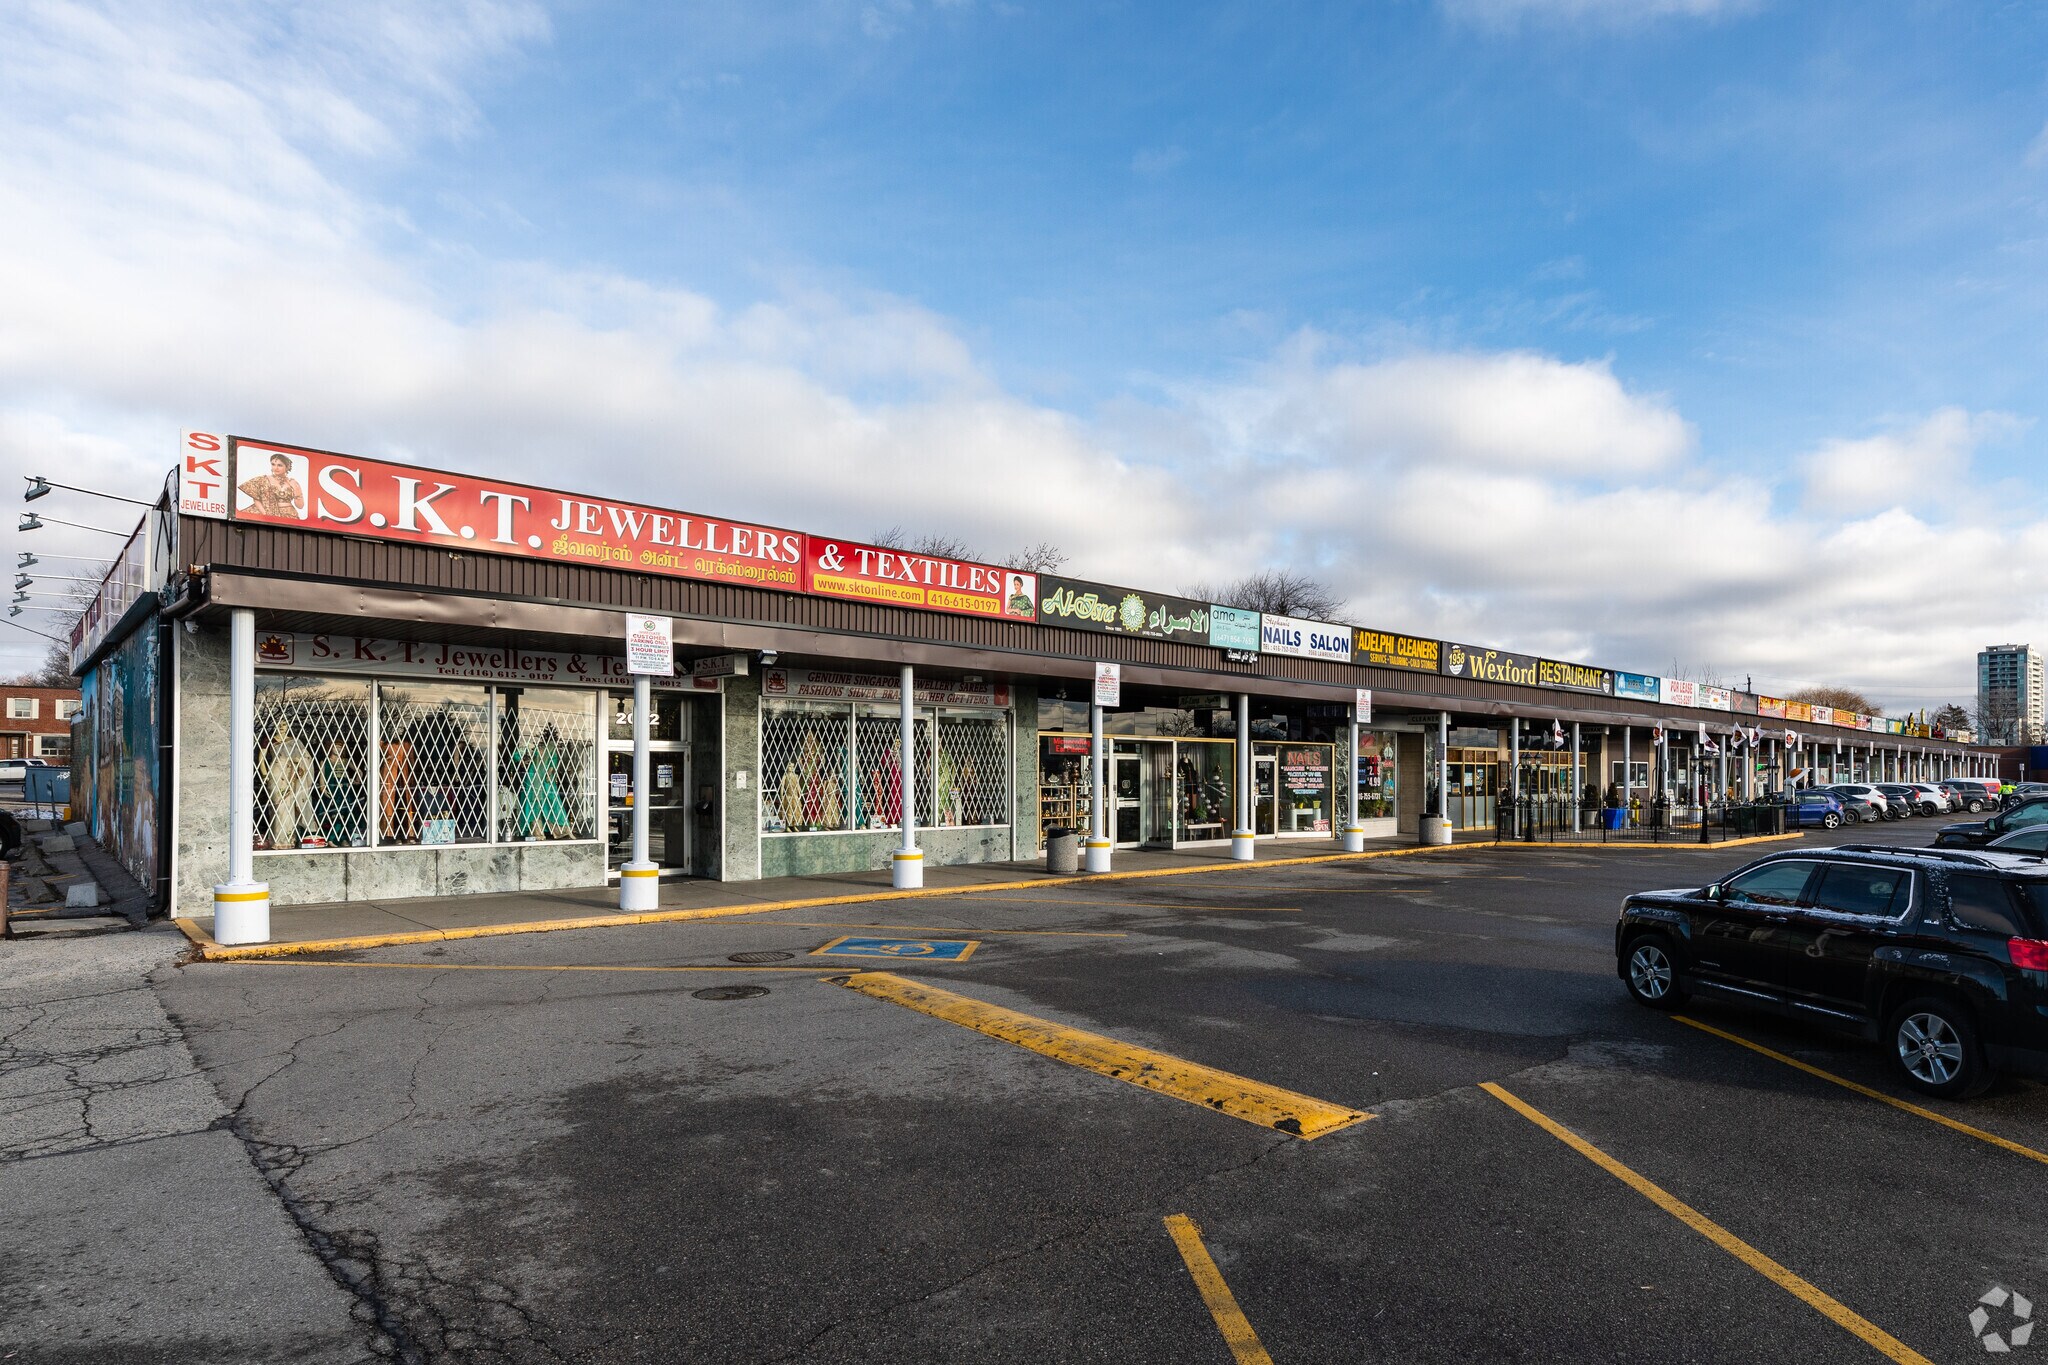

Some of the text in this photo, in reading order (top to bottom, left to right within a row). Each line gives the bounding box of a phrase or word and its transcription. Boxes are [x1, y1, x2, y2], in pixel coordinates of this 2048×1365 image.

[180, 499, 226, 514] JEWELLERS
[316, 464, 1001, 594] S.K.T. JEWELLERS & TEXTILES
[817, 578, 921, 601] www.sktonline.com
[930, 593, 997, 612] 416-615-0197
[1213, 609, 1235, 622] ama
[632, 633, 667, 641] CUSTOMER
[1263, 626, 1349, 653] NAILS SALON
[1358, 631, 1438, 660] ADELPHI CLEANERS
[434, 643, 558, 673] Jewellers
[566, 654, 588, 674] &
[1448, 652, 1465, 665] 1958
[436, 667, 459, 675] Tel:
[463, 668, 493, 678] (416)
[497, 671, 517, 679] 615
[529, 673, 555, 681] 0197
[1469, 651, 1602, 688] Wexford RESTAURANT
[579, 675, 600, 683] Fax:
[604, 678, 630, 686] (416)
[807, 672, 989, 693] GENUINE SINGAPOR EWELLERY SAREES
[1670, 680, 1679, 693] FOR
[1680, 681, 1693, 695] LEASE
[797, 684, 844, 697] FASHIONS
[847, 687, 878, 699] SILVER
[918, 691, 945, 702] OTHER
[946, 693, 965, 704] GIFT
[965, 695, 989, 705] ITEMS
[1287, 751, 1321, 766] NAILS
[1314, 823, 1329, 831] OPEN
